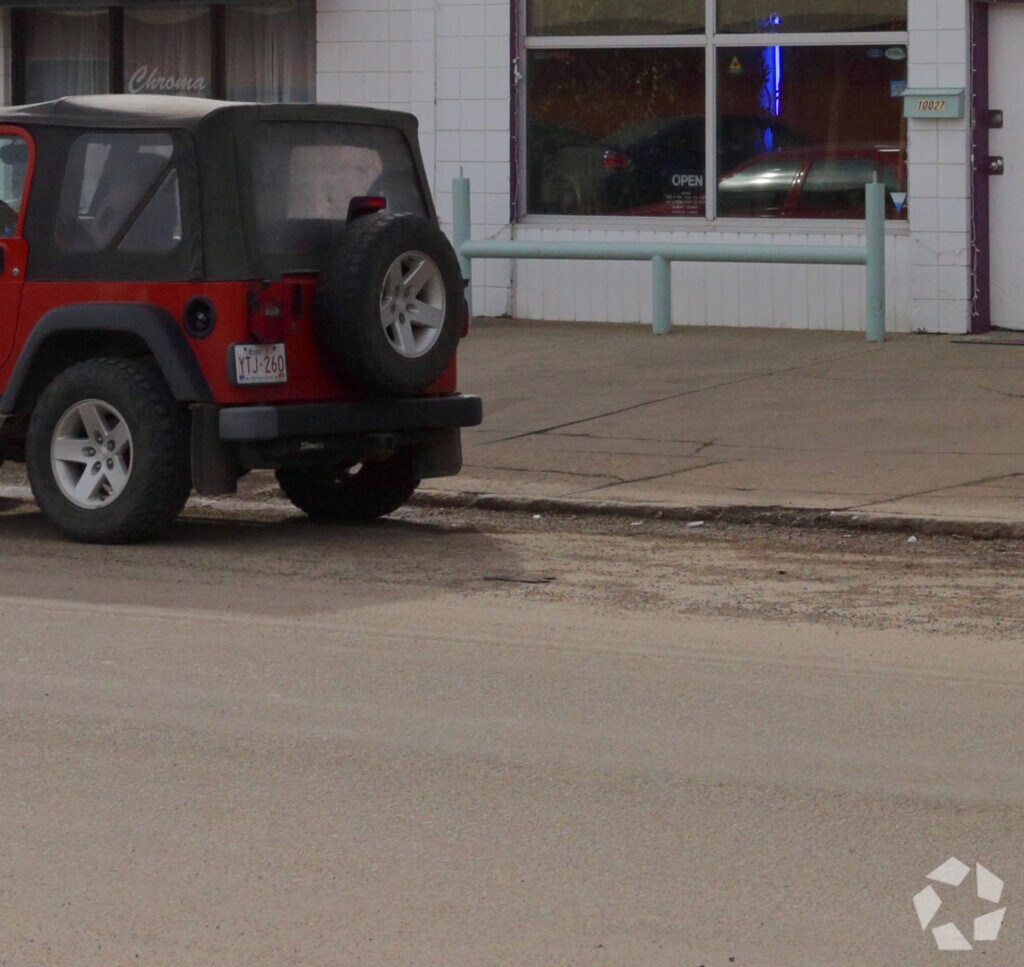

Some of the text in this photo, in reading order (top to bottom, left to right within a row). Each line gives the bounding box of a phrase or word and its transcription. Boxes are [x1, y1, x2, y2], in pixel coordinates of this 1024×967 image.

[128, 65, 207, 93] Chroma
[918, 100, 945, 111] 10027
[672, 174, 703, 186] OPEN
